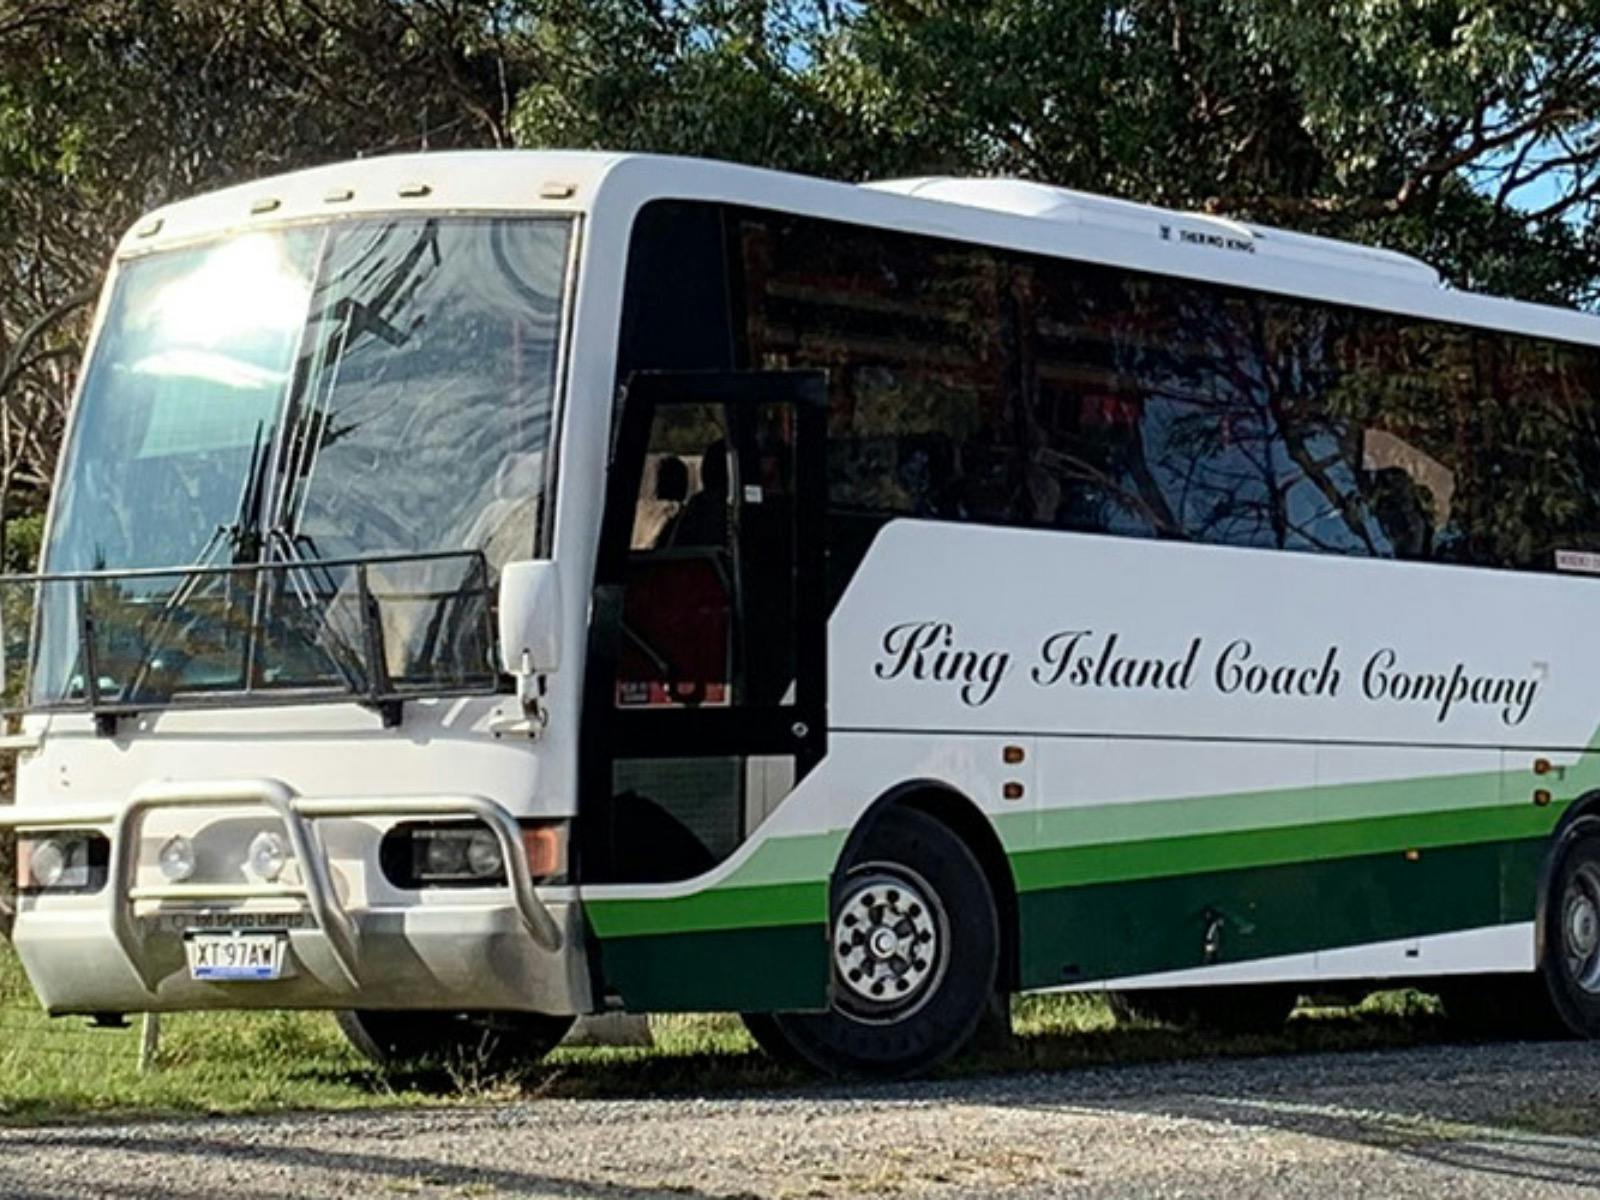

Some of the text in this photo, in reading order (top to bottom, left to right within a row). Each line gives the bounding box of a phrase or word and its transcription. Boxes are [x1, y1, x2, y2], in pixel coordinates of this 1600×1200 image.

[874, 621, 1538, 726] King Island Coach Company
[217, 914, 254, 926] SPEED
